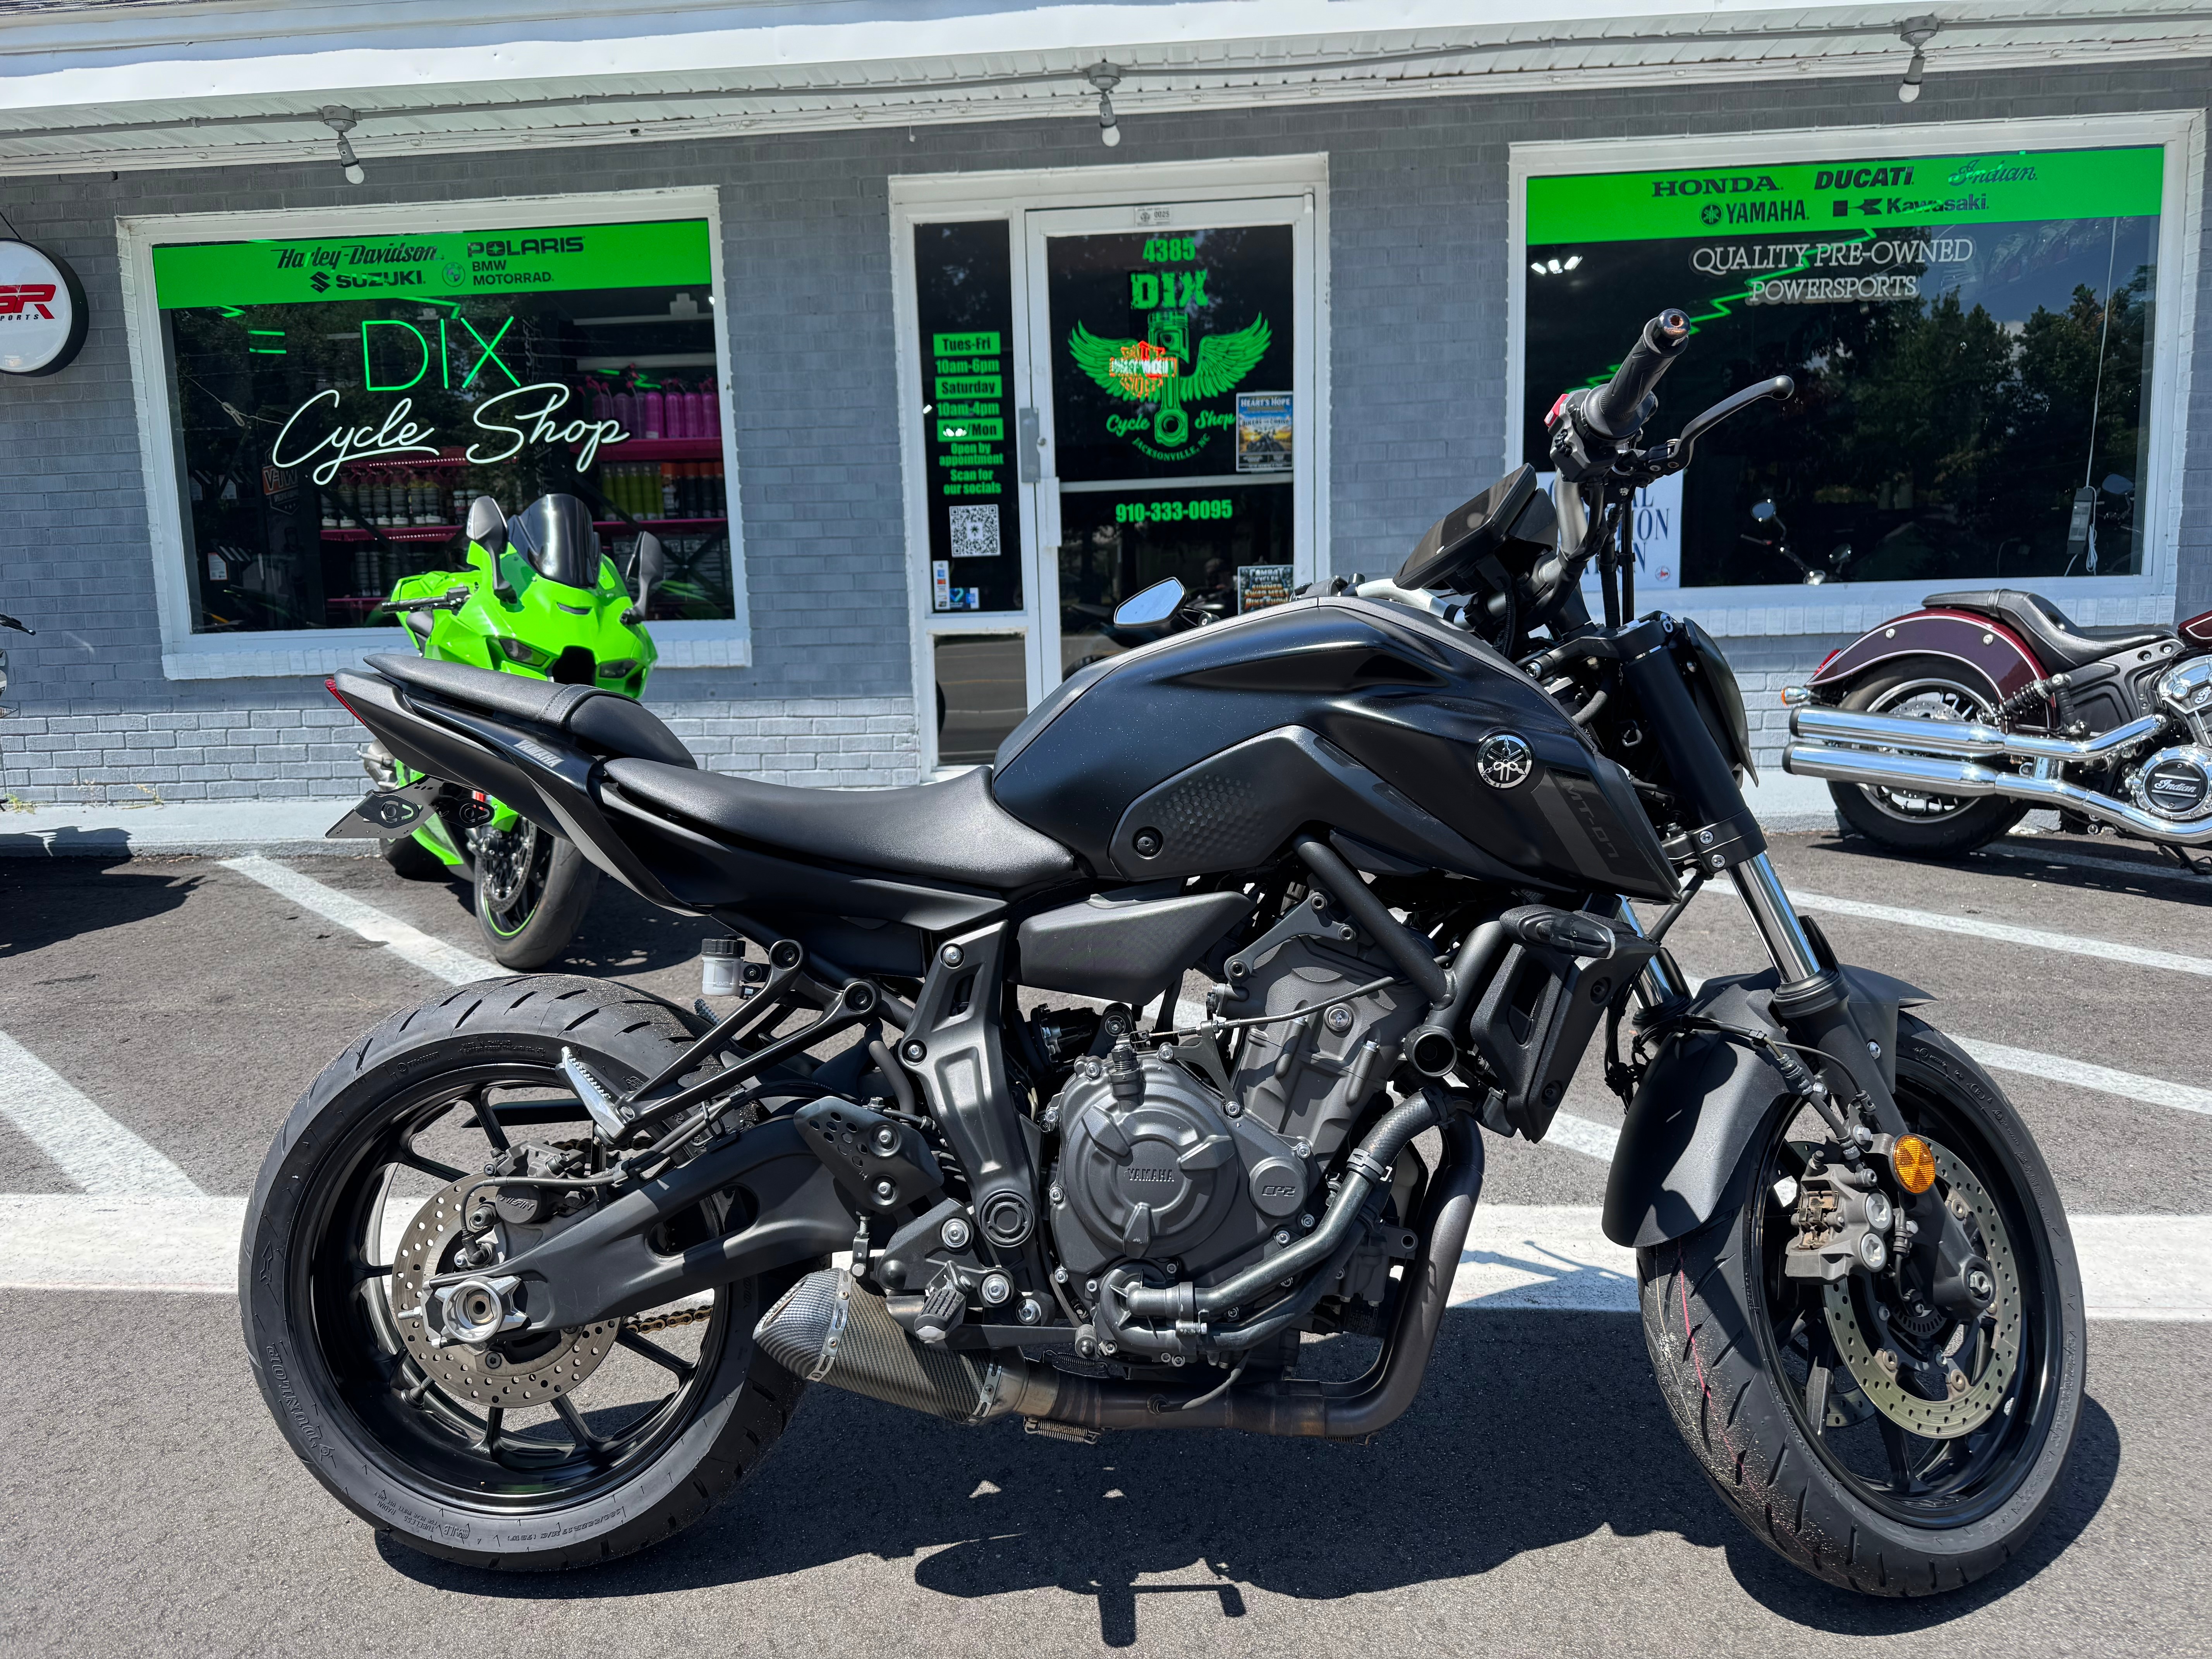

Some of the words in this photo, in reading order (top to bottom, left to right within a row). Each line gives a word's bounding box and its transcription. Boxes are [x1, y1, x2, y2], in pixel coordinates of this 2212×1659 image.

[1948, 159, 2036, 186] Indian
[1652, 176, 1780, 197] HONDA
[1725, 199, 1806, 224] YAMAHA
[1887, 194, 1987, 215] Kawasaki
[467, 236, 584, 258] POLARIS
[1142, 237, 1196, 263] 4385
[472, 259, 507, 272] BMW
[1692, 244, 1810, 276] QUALITY
[1815, 239, 1973, 267] PRE-OWNED
[336, 270, 423, 289] SUZUKI
[473, 272, 552, 286] MOTORRAD
[1130, 270, 1209, 309] DIX
[1749, 276, 1917, 302] POWERSPORTS
[943, 336, 991, 351] Tues-Fri
[362, 316, 521, 391] DIX
[936, 358, 1000, 374] 10am-6pm
[941, 380, 995, 395] Saturday
[936, 401, 1000, 417] 10am-4pm
[1106, 414, 1151, 437] Cycle
[1194, 410, 1237, 431] Shop
[273, 389, 440, 486] Cycle
[465, 383, 630, 472] Shop
[1198, 433, 1211, 448] NC
[951, 443, 977, 455] Open
[978, 442, 991, 455] by
[939, 453, 1004, 467] appointment
[950, 469, 977, 482] Scan
[978, 469, 994, 481] for
[943, 484, 962, 495] our
[963, 481, 1002, 495] socials
[1116, 499, 1233, 523] 910-333-0095
[513, 739, 565, 768] YAMAHA
[2154, 779, 2197, 793] Indian
[1561, 781, 1620, 858] MT-07
[1127, 1168, 1175, 1182] YAMAHA
[1261, 1185, 1296, 1197] CP2
[266, 1345, 321, 1441] DUNLOP
[377, 1500, 397, 1515] RADIAL
[404, 1516, 434, 1532] TUBELESS
